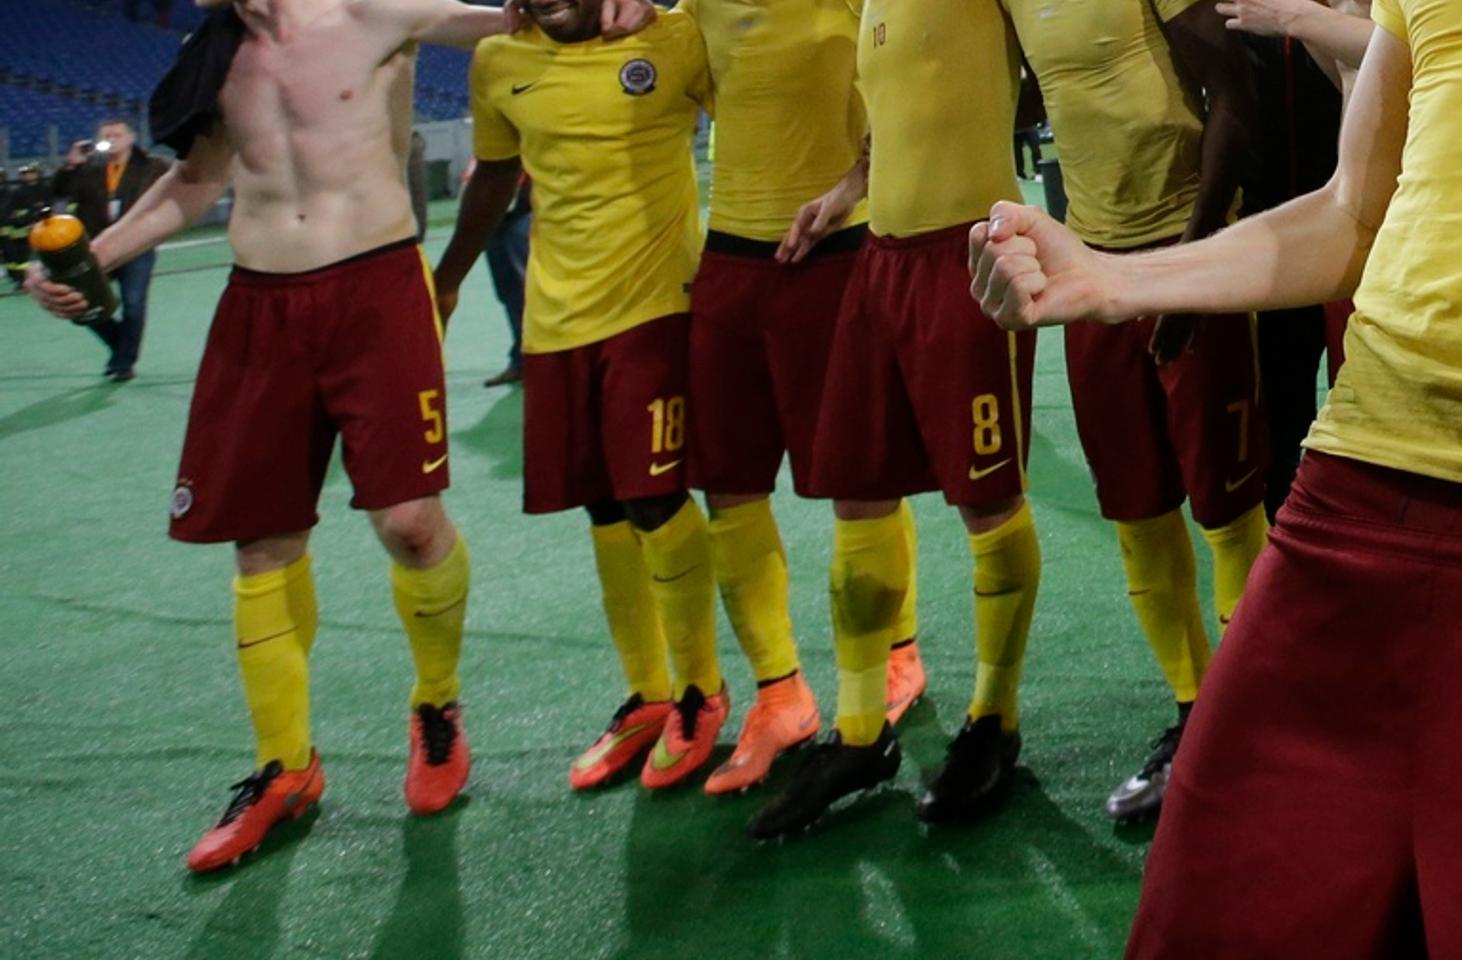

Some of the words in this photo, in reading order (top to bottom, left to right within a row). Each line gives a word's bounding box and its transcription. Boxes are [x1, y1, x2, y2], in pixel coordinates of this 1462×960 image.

[419, 390, 444, 444] 5
[647, 396, 685, 453] 18
[972, 393, 1002, 455] 8
[1226, 399, 1250, 462] 7
